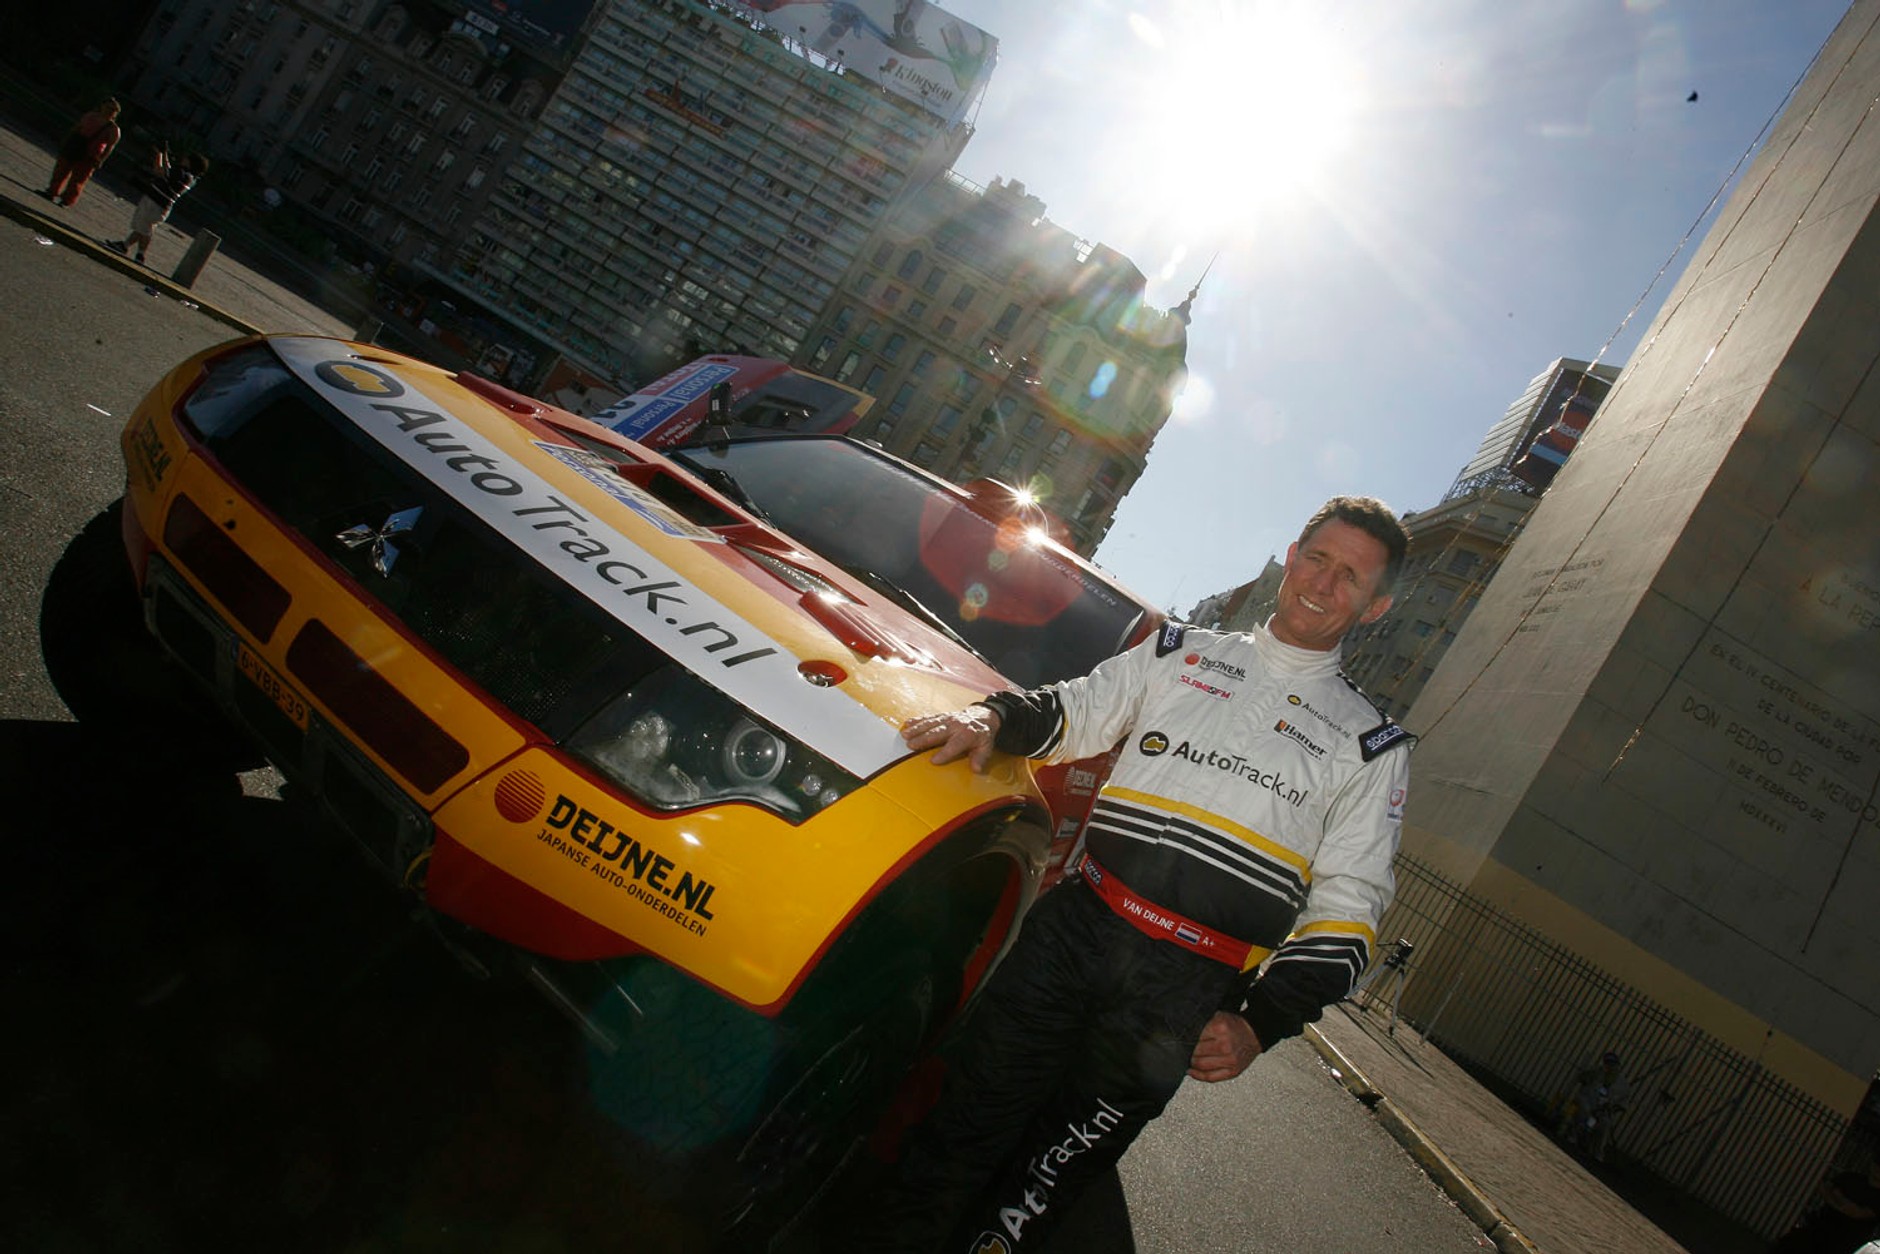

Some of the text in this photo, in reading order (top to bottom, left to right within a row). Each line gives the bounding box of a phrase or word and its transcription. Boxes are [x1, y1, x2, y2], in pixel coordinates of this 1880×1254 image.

[895, 65, 953, 101] Kingston
[669, 366, 730, 399] Personal
[371, 402, 777, 668] AutoTrack.nl
[1729, 655, 1743, 671] EL
[1760, 674, 1832, 723] CENTENARIO
[1757, 698, 1775, 716] DE
[1283, 723, 1328, 756] Hamer
[1302, 702, 1352, 740] AutoTrack.nl
[1682, 695, 1721, 729] DON
[1725, 721, 1784, 766] PEDRO
[1788, 759, 1815, 786] DE
[1171, 741, 1309, 808] AutoTrack.nl
[1736, 763, 1754, 781] DE
[1755, 774, 1809, 813] FEBRERO
[1810, 807, 1828, 824] DE
[536, 829, 707, 937] JAPANSE AUTO-ONDERDELEN
[545, 793, 716, 921] DEIJNE.NL
[1122, 898, 1216, 948] VAN DEIJNE A+
